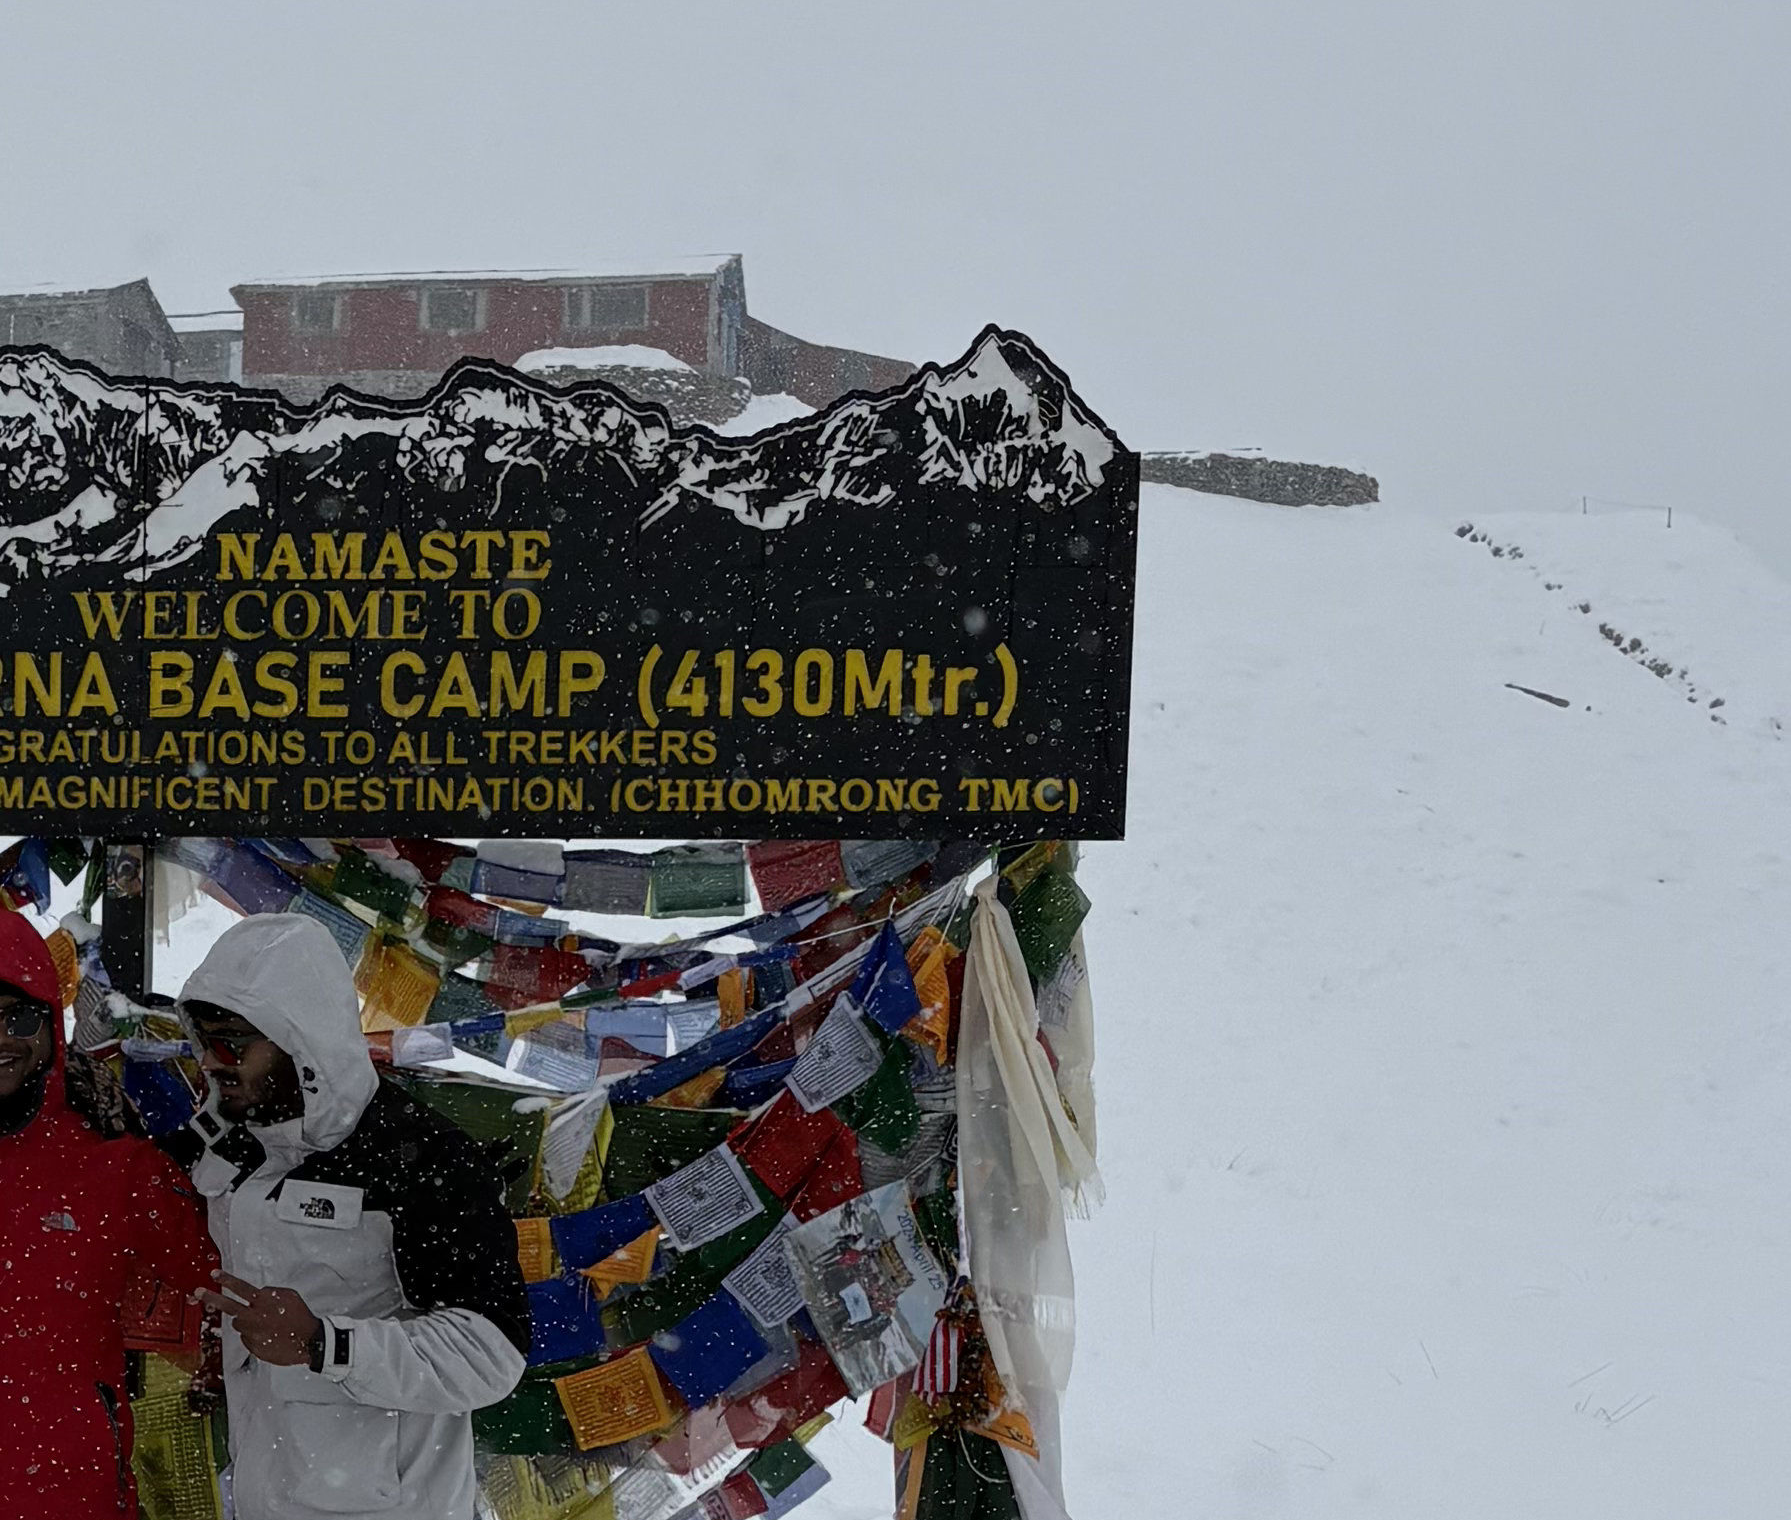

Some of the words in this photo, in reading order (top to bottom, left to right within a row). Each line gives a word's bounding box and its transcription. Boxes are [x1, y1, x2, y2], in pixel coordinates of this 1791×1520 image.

[215, 530, 552, 582] NAMASTE
[72, 589, 429, 641] WELCOME
[447, 589, 542, 640] TO
[148, 650, 350, 718] BASE
[379, 649, 606, 719] CAMP
[637, 643, 1020, 729] (4130Mtr.)
[321, 729, 376, 765] TO
[386, 730, 465, 764] ALL
[481, 729, 718, 765] TREKKERS
[610, 777, 941, 813] (CHHOMRONG
[957, 777, 1080, 814] TMC)
